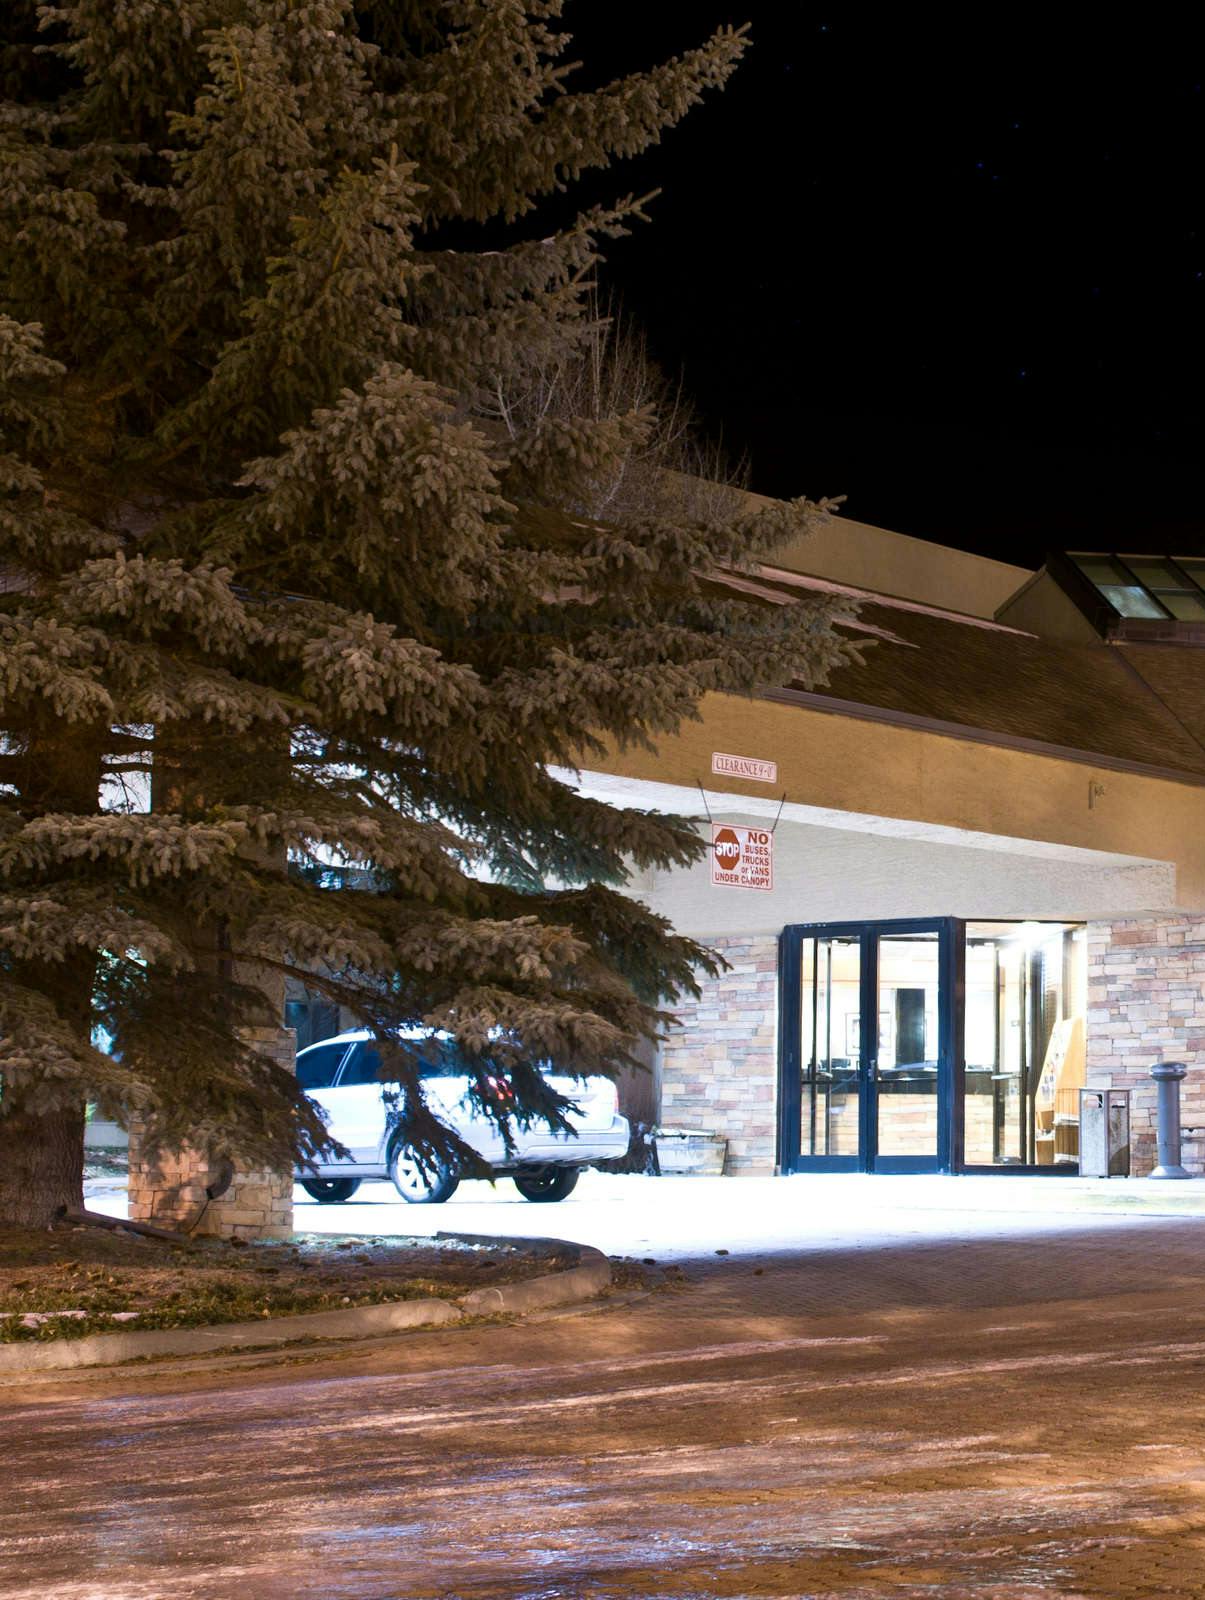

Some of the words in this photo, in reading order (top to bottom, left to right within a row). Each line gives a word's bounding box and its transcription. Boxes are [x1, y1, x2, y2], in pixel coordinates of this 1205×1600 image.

[716, 757, 758, 775] CLEARANCE
[748, 831, 769, 845] NO
[715, 841, 740, 858] STOP
[742, 855, 769, 867] TRUCKS
[750, 866, 769, 877] VANS
[715, 872, 739, 884] UNDER
[741, 875, 770, 887] CANOPY
